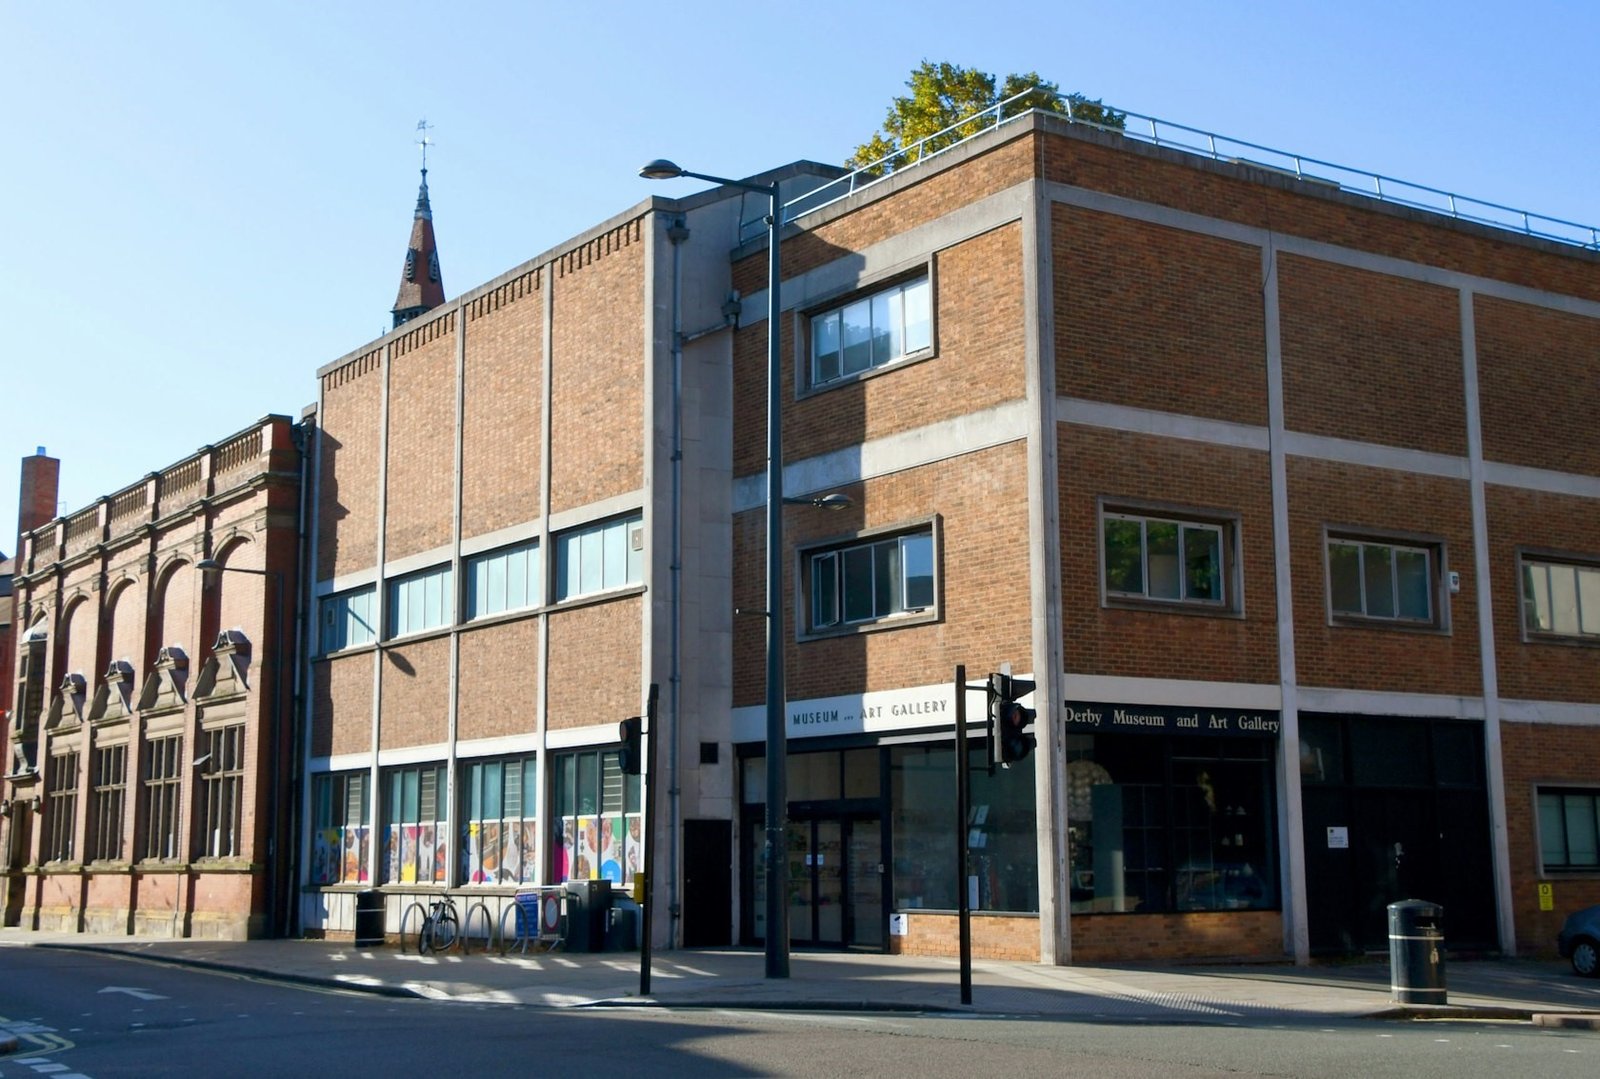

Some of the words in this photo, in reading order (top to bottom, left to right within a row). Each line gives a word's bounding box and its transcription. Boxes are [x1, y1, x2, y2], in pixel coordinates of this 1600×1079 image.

[793, 710, 838, 725] MUSEUM
[860, 706, 882, 719] ART
[891, 700, 947, 716] GALLERY
[1065, 707, 1102, 726] Derby
[1113, 709, 1165, 726] Museum
[1177, 713, 1198, 728] and
[1208, 714, 1228, 729] Art
[1238, 715, 1280, 733] Gallery
